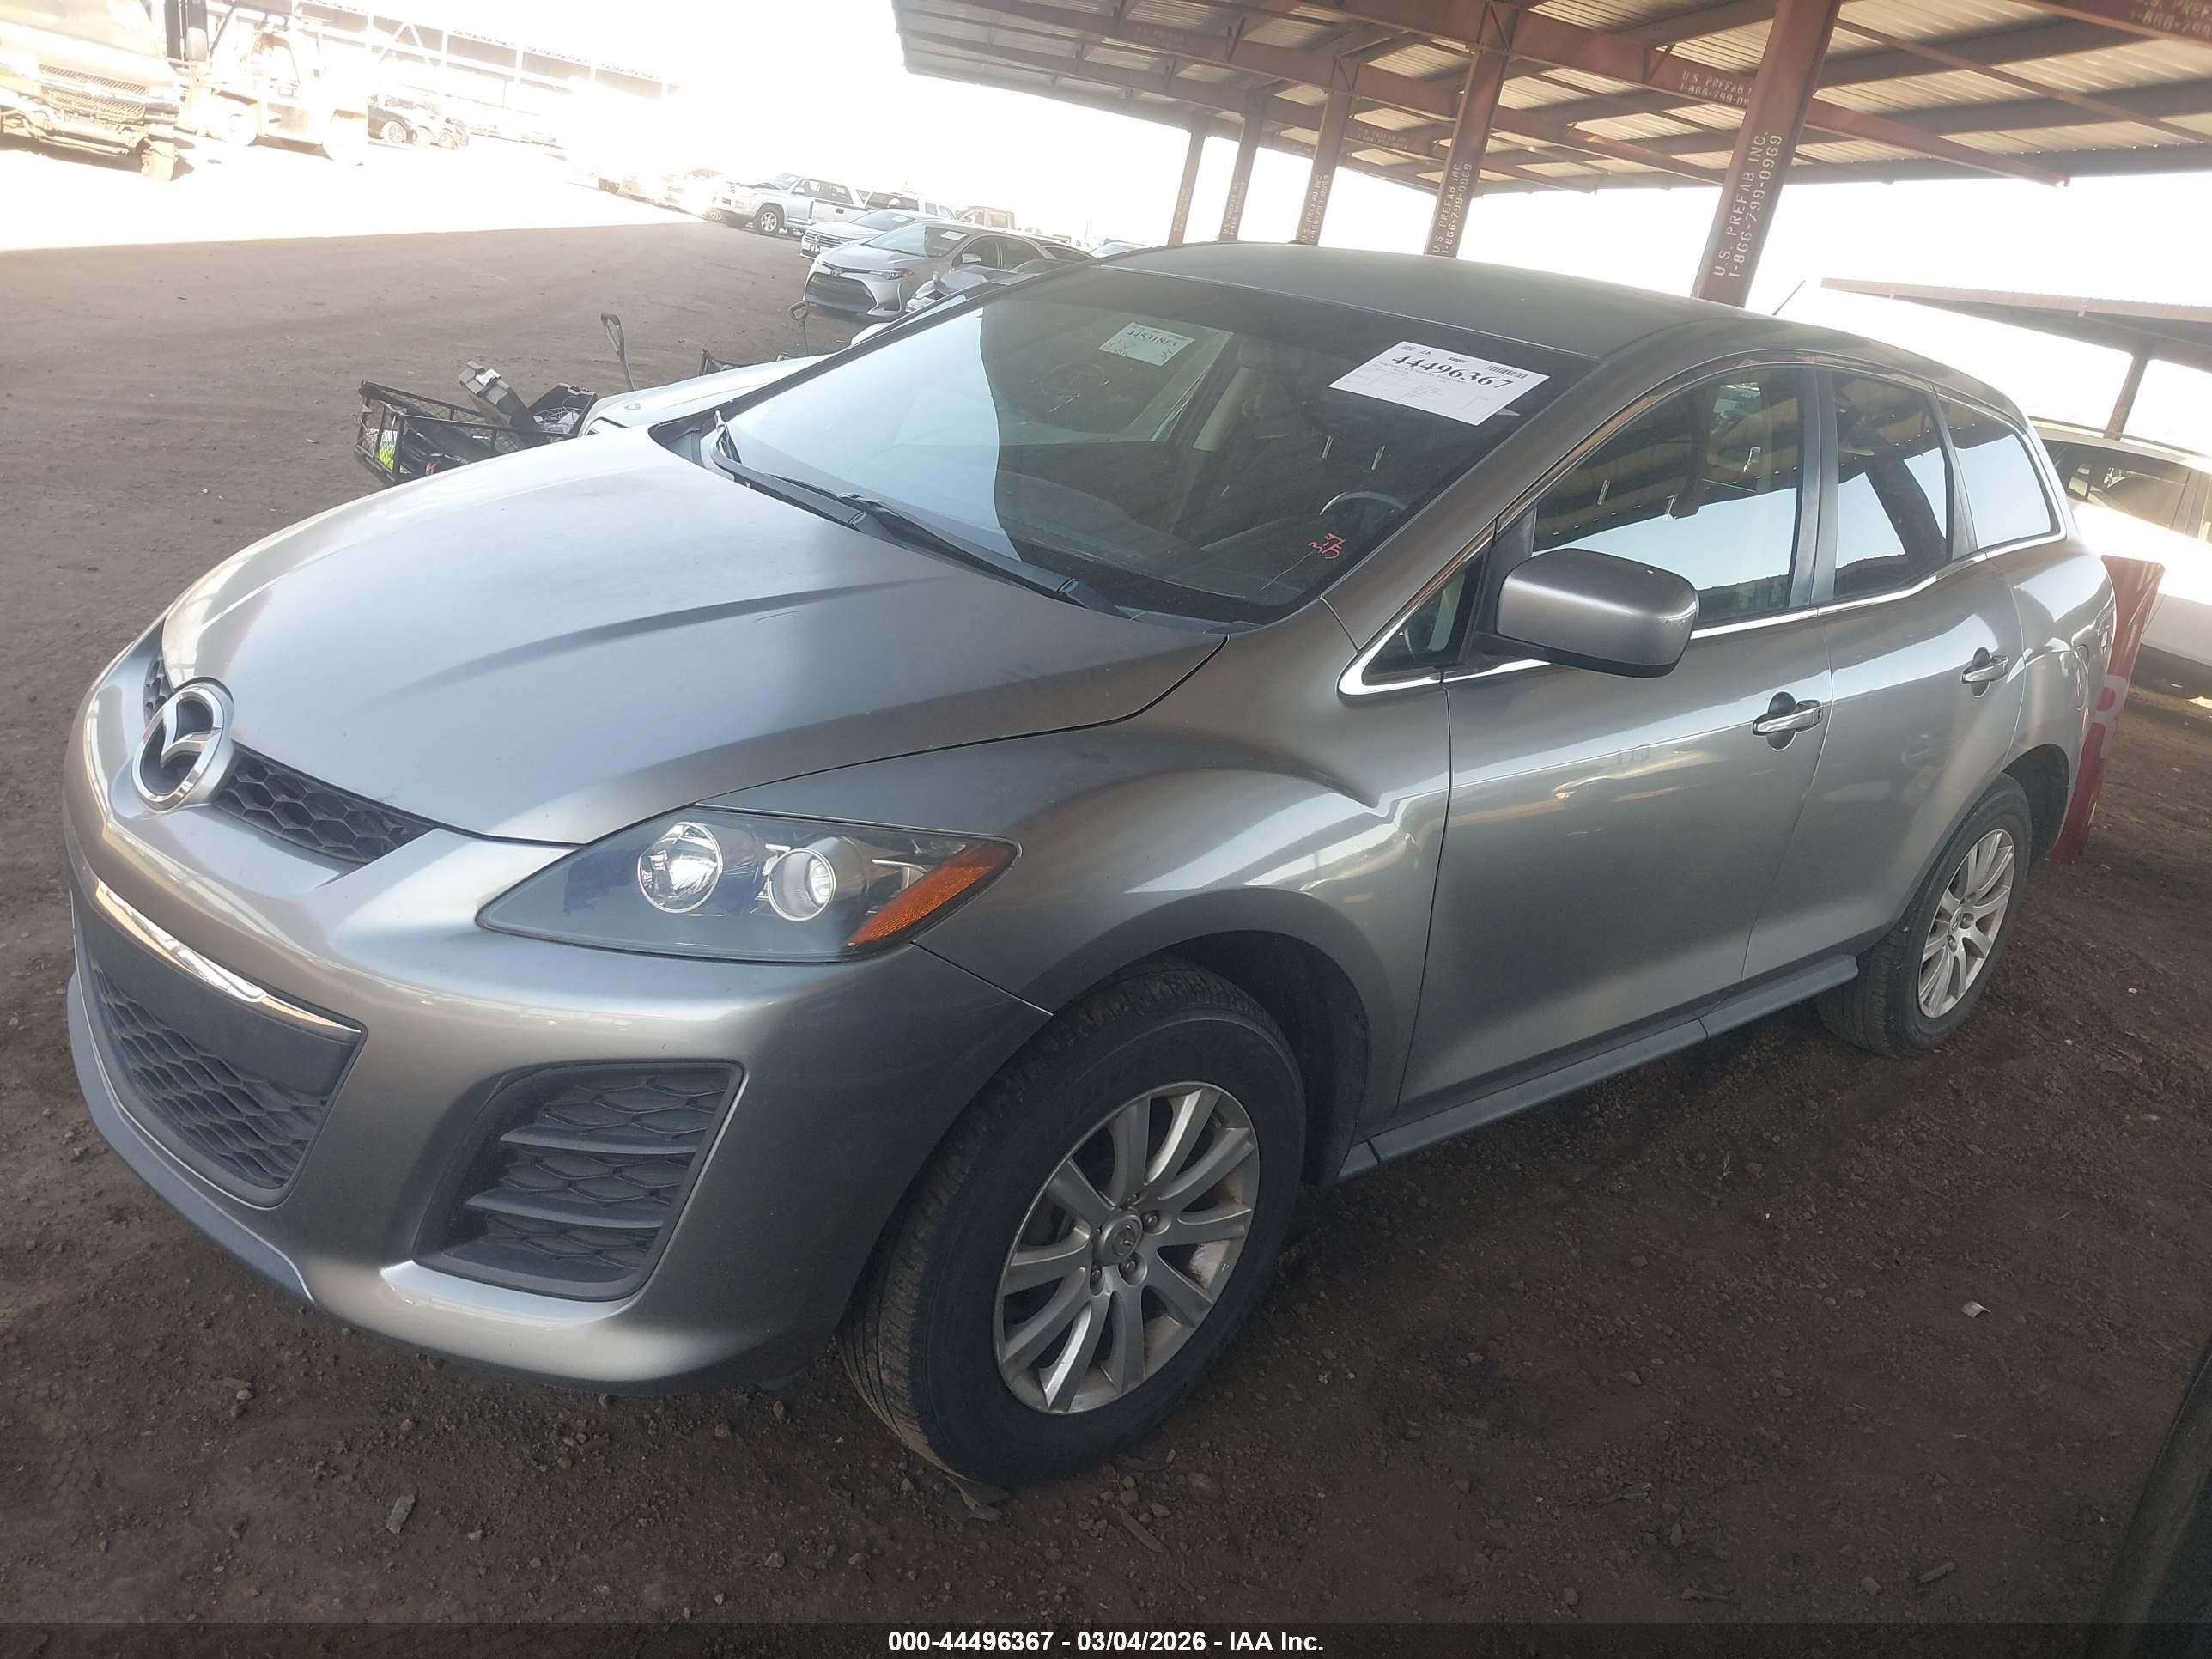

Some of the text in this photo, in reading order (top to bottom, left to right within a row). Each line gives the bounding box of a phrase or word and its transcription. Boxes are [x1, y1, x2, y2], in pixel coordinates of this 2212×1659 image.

[1439, 186, 1456, 228] PREFAB
[1713, 131, 1769, 276] U.S. PREFAB INC.
[1728, 135, 1784, 277] 1-866-799-0969
[1391, 356, 1514, 389] 44496367
